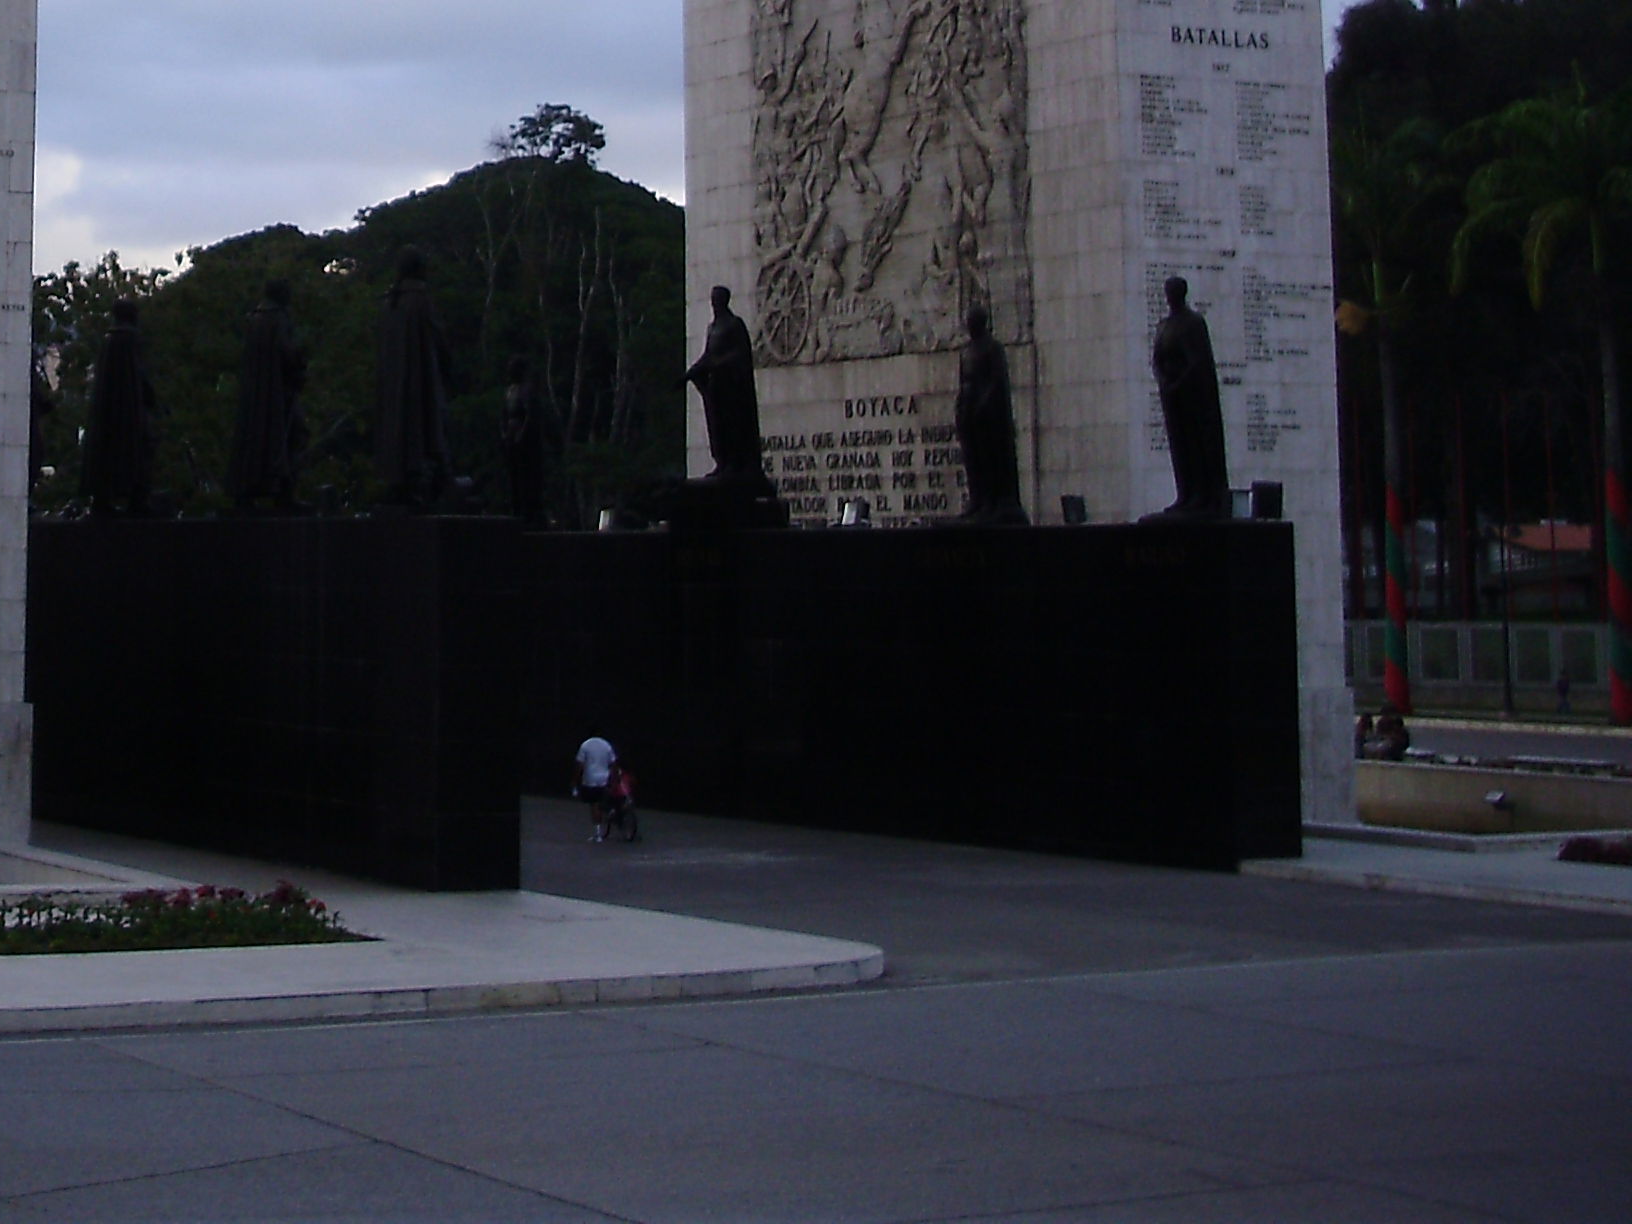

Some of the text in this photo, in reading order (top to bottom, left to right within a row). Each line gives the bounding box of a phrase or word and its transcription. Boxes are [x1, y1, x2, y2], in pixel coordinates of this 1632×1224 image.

[1171, 25, 1269, 50] BATALLAS
[845, 396, 919, 420] BOYACA
[812, 432, 834, 451] QUE
[898, 426, 914, 444] LA
[783, 455, 816, 472] NUEVA
[826, 450, 881, 469] GRANADA
[892, 449, 913, 467] HOY
[828, 473, 881, 491] LIBRADA
[893, 470, 916, 489] POR
[928, 470, 945, 488] EL
[876, 494, 892, 512] EL
[903, 492, 948, 511] MANDO
